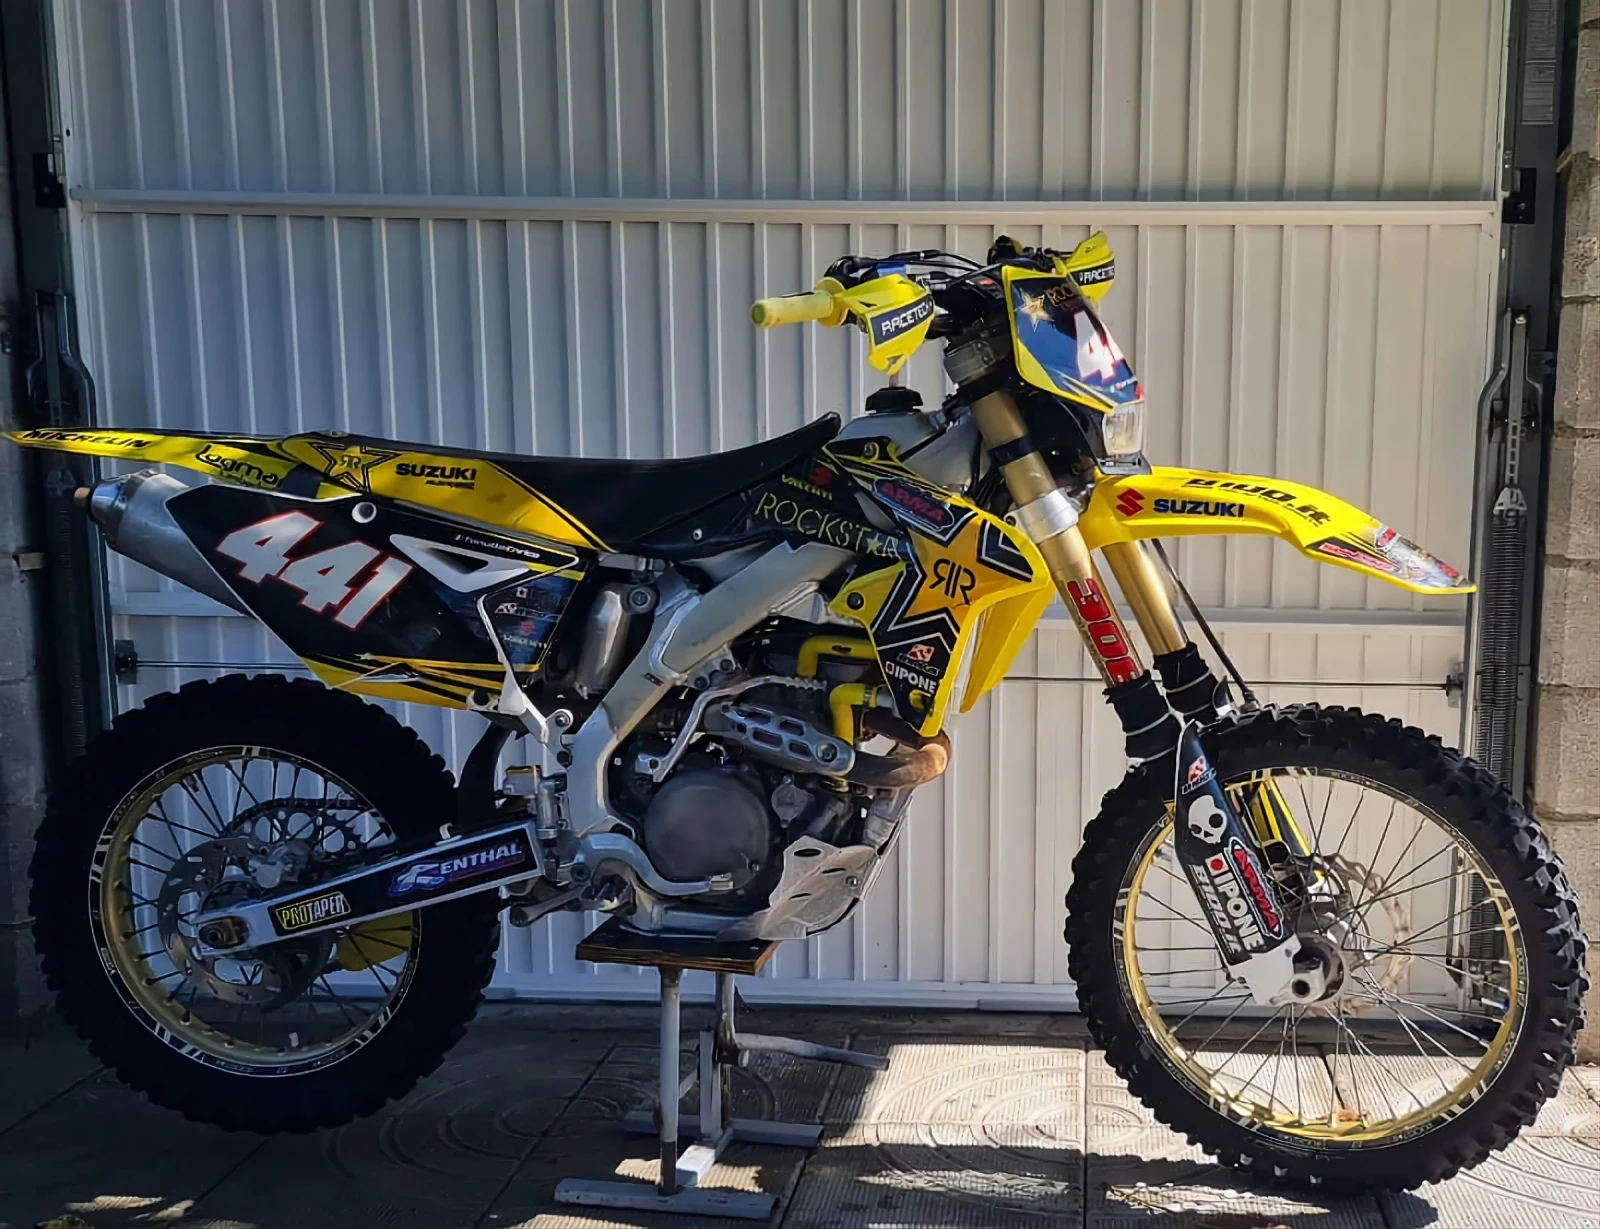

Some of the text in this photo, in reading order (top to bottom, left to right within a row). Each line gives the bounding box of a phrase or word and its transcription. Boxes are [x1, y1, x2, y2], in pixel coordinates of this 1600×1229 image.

[881, 300, 932, 336] RACETEC
[21, 430, 153, 449] MICHELIN
[395, 463, 477, 481] SUZUKI
[1153, 498, 1246, 518] SUZUKI
[754, 492, 906, 562] ROCKSTA
[215, 509, 414, 631] 441
[894, 665, 937, 694] IPONE
[1233, 848, 1280, 934] ARMA
[281, 893, 346, 925] PROTAPER
[1214, 869, 1266, 951] IPONE
